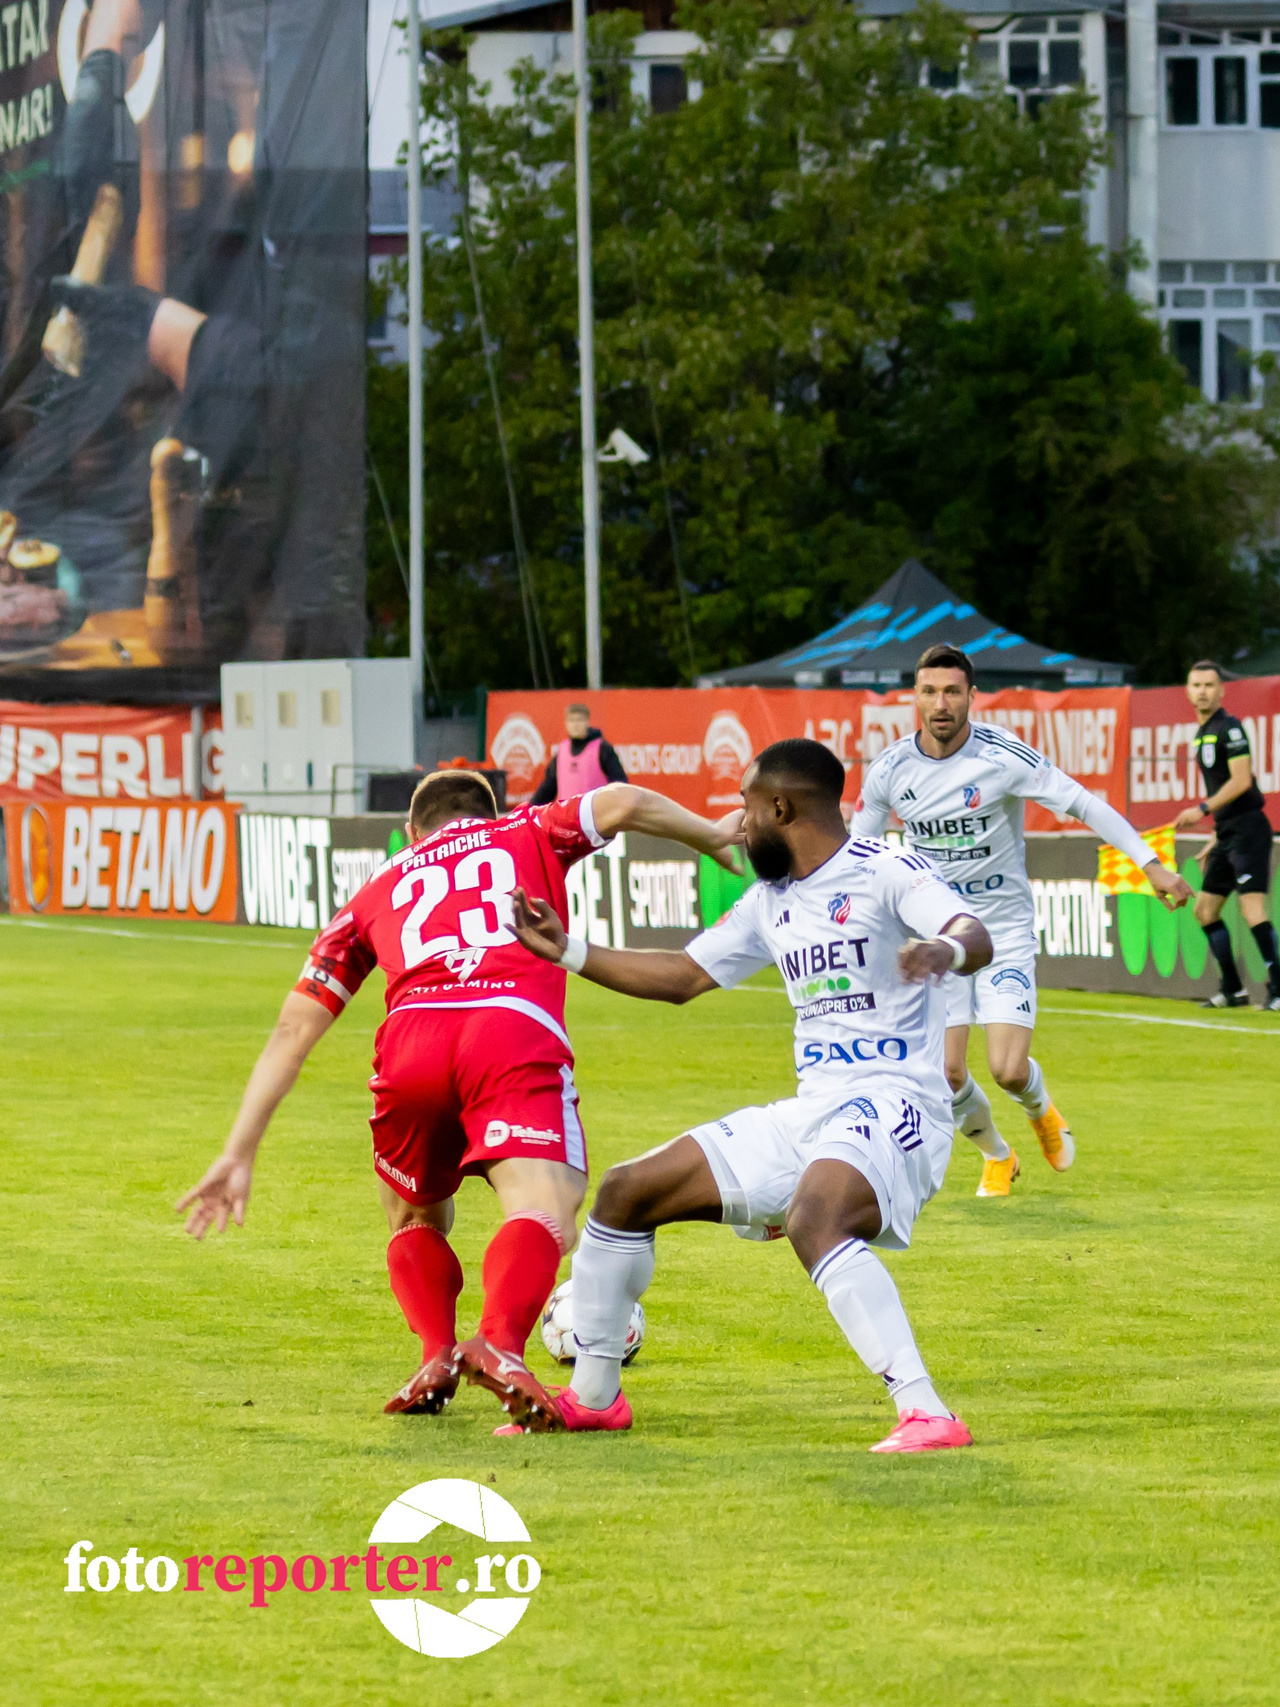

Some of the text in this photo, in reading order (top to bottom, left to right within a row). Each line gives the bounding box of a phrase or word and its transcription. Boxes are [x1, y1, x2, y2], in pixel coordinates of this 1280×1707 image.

[62, 806, 226, 914] BETANO
[239, 813, 331, 930] UNIBET
[402, 829, 491, 874] PATRICHE
[391, 848, 517, 969] 23
[780, 937, 870, 982] NIBET
